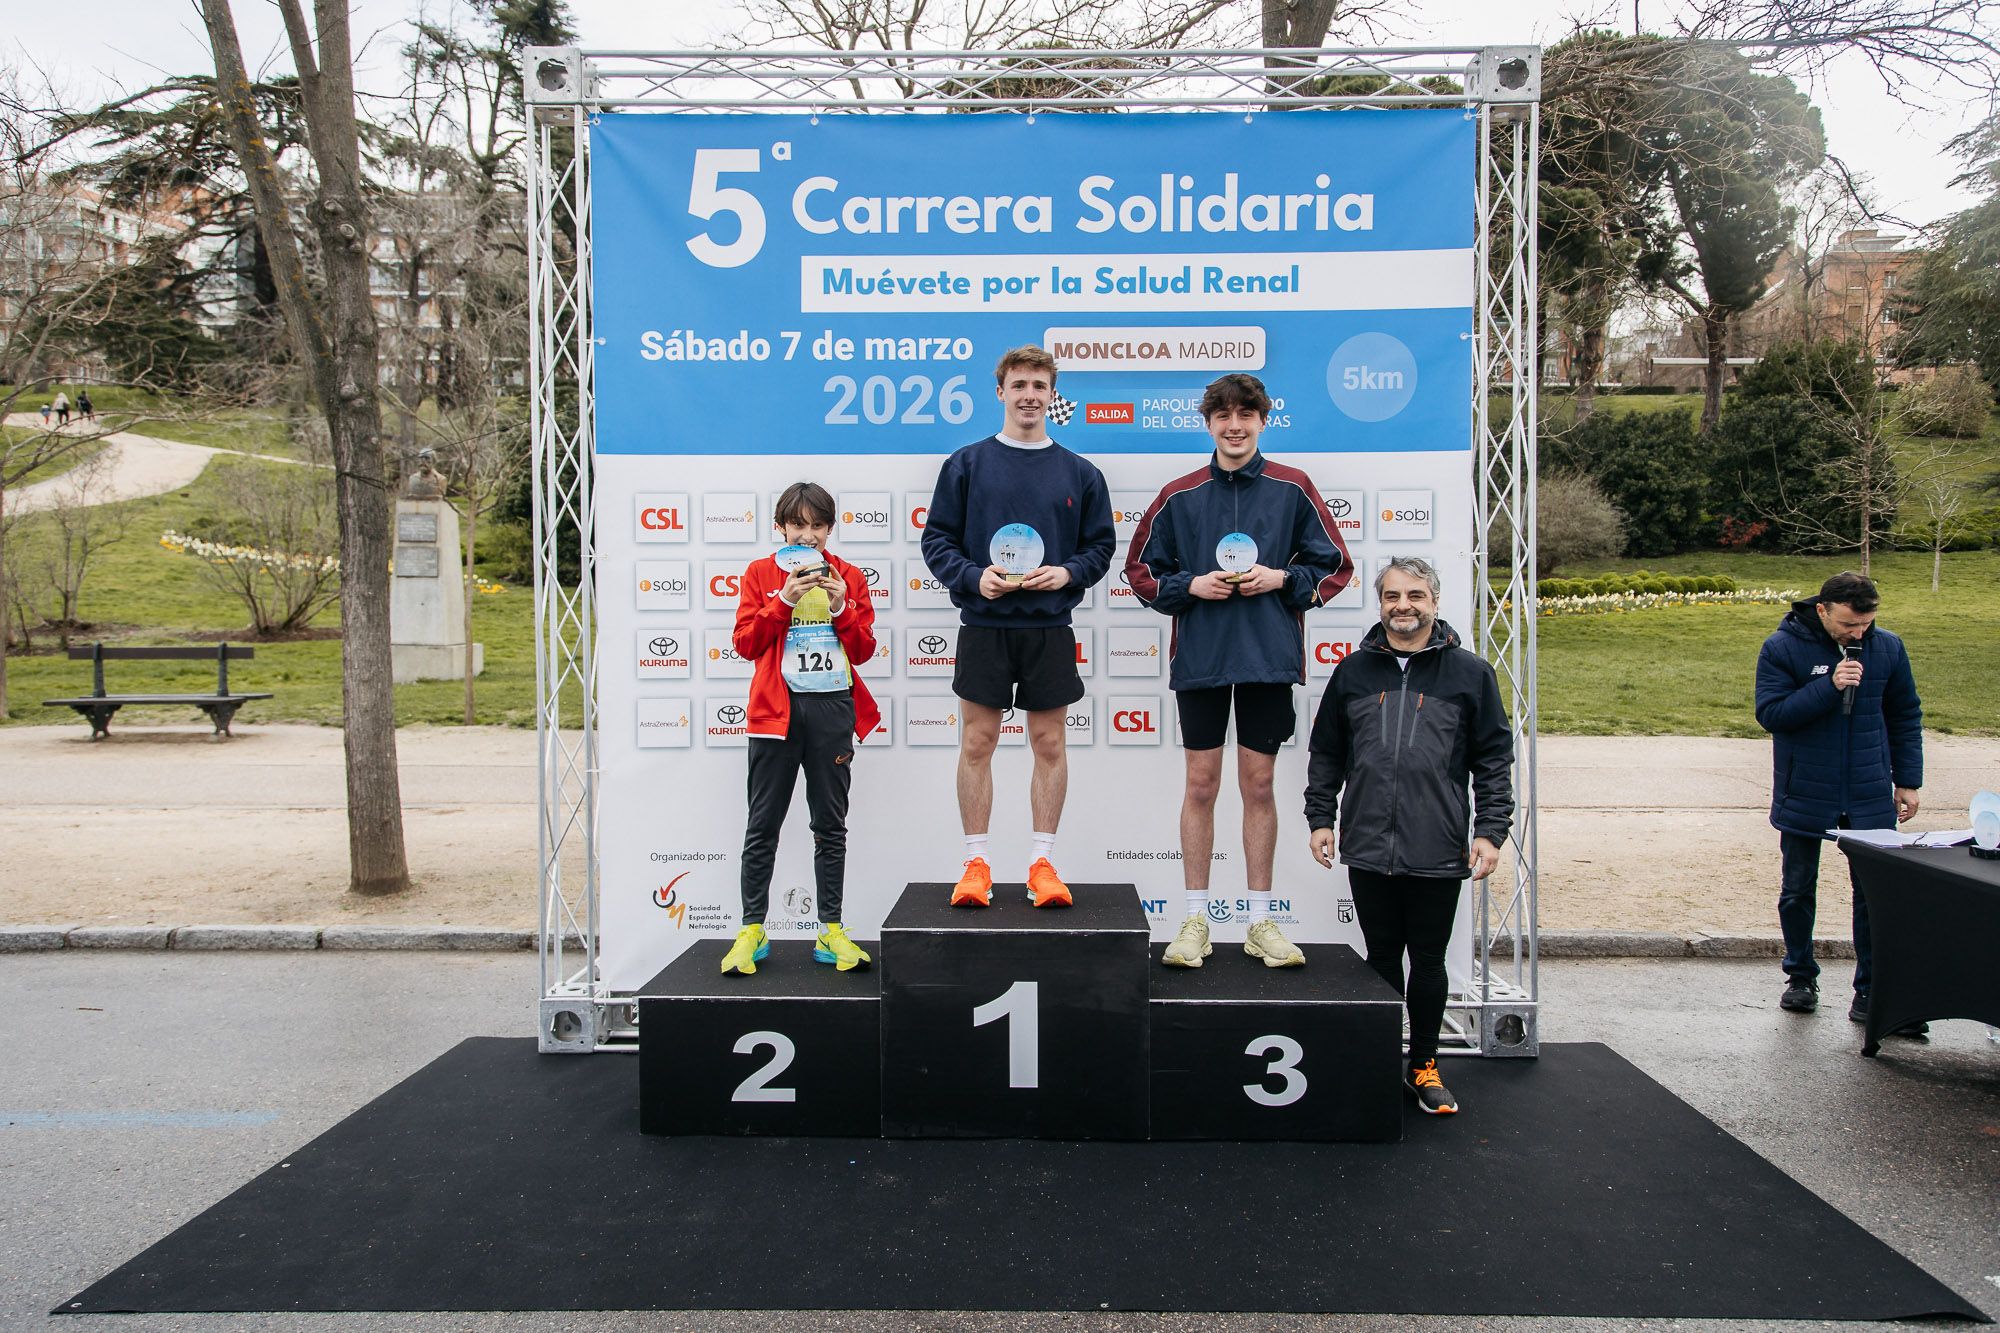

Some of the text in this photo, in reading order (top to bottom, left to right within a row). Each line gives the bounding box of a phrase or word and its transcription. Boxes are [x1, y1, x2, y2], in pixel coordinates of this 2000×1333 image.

[792, 175, 1053, 235] Carrera
[1075, 172, 1375, 234] Solidaria
[822, 264, 1300, 302] Muévete por la Salud Renal
[640, 329, 974, 361] Sábado 7 de marzo
[1053, 341, 1256, 360] MONCLOA MADRID
[1343, 365, 1404, 391] 5km
[823, 374, 974, 425] 2026
[1142, 398, 1199, 412] PARQUE
[1090, 409, 1129, 420] SALIDA
[1142, 415, 1207, 428] DEL OEST
[1265, 414, 1291, 428] RAS
[640, 508, 684, 530] CSL
[705, 515, 745, 523] AstraZeneca
[855, 510, 888, 523] sobi
[1395, 508, 1430, 521] sobi
[653, 578, 687, 592] sobi
[1110, 588, 1135, 597] KUR
[798, 652, 833, 673] 126
[1065, 713, 1090, 727] obi
[1113, 710, 1156, 733] CSL
[650, 852, 727, 864] Organizado por:
[1106, 850, 1228, 860] Entidades colabras:
[1236, 899, 1291, 911] SEN
[973, 980, 1039, 1089] 1
[731, 1030, 796, 1102] 2
[1242, 1034, 1308, 1107] 3
